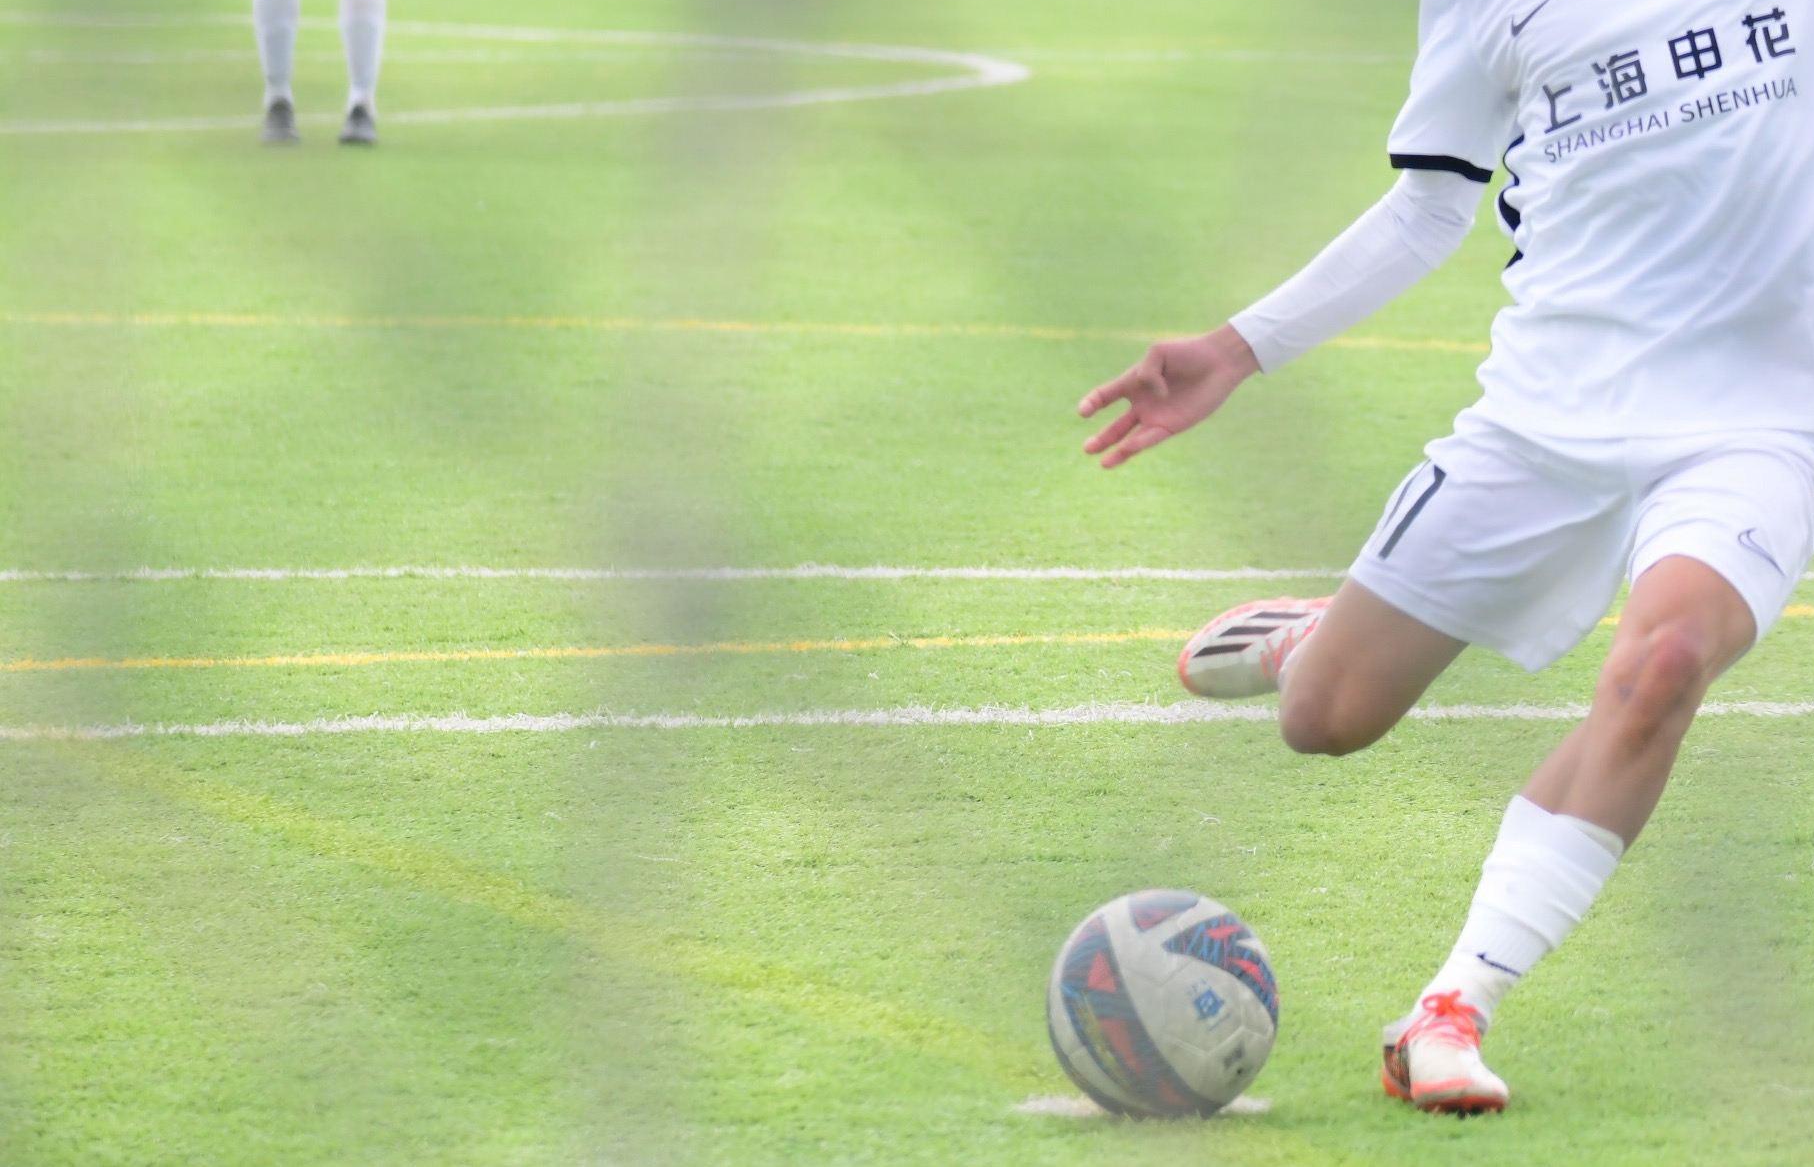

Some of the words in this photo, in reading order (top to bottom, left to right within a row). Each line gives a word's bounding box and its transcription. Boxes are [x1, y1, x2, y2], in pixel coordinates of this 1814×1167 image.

[1542, 7, 1796, 134] 上海申花
[1544, 110, 1670, 164] SHANGHAI
[1680, 77, 1798, 123] SHENHUA
